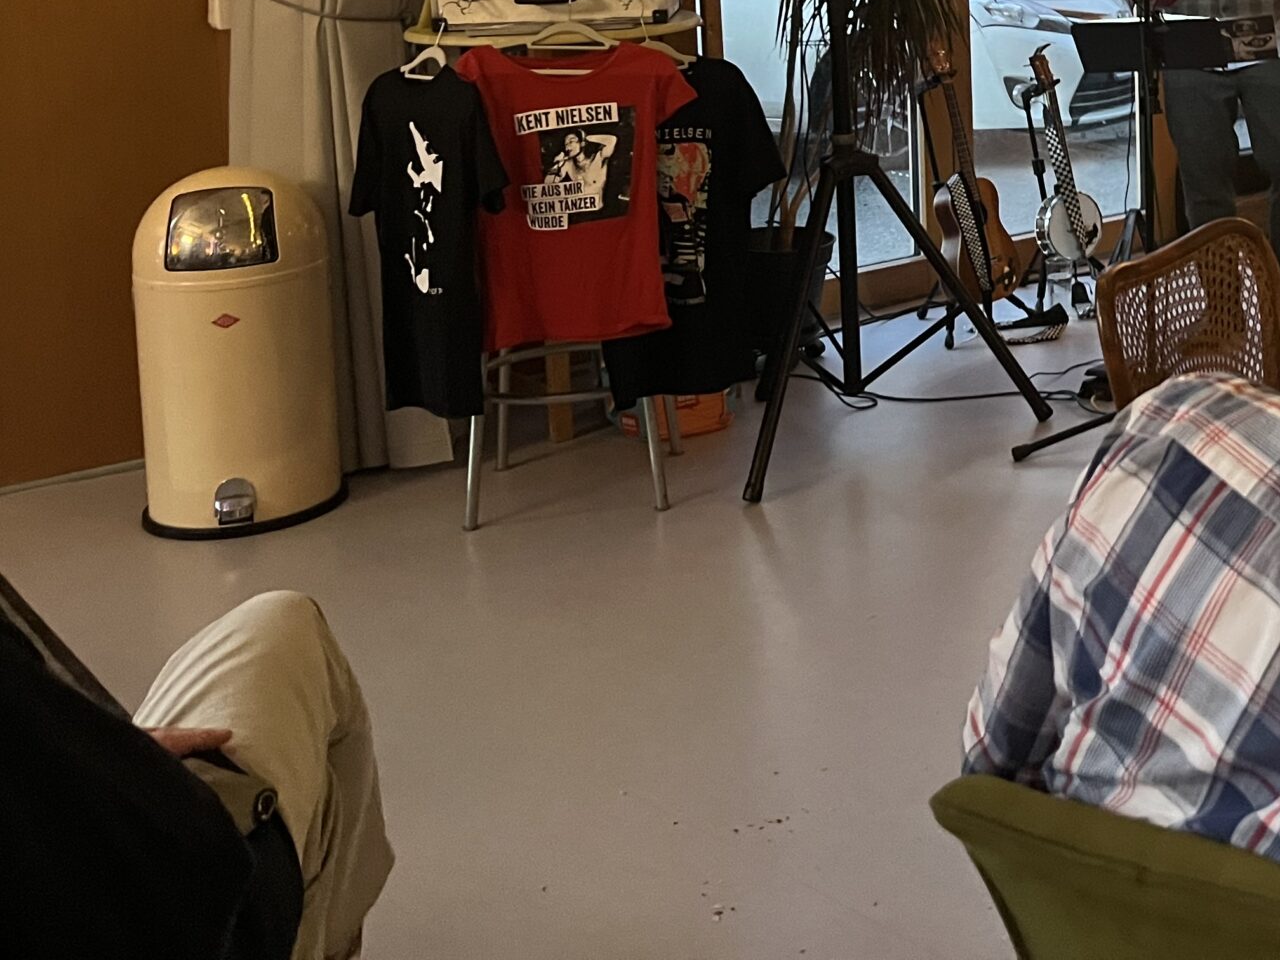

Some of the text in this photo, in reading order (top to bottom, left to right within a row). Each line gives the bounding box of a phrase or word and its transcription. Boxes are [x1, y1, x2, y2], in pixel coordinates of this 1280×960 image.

[516, 104, 612, 133] KENT NIELSEN
[655, 127, 712, 140] NIELSEN
[541, 184, 561, 197] AUS
[564, 181, 583, 196] MIR
[531, 196, 597, 215] KEIN TÄNZER
[529, 214, 565, 229] WURDE
